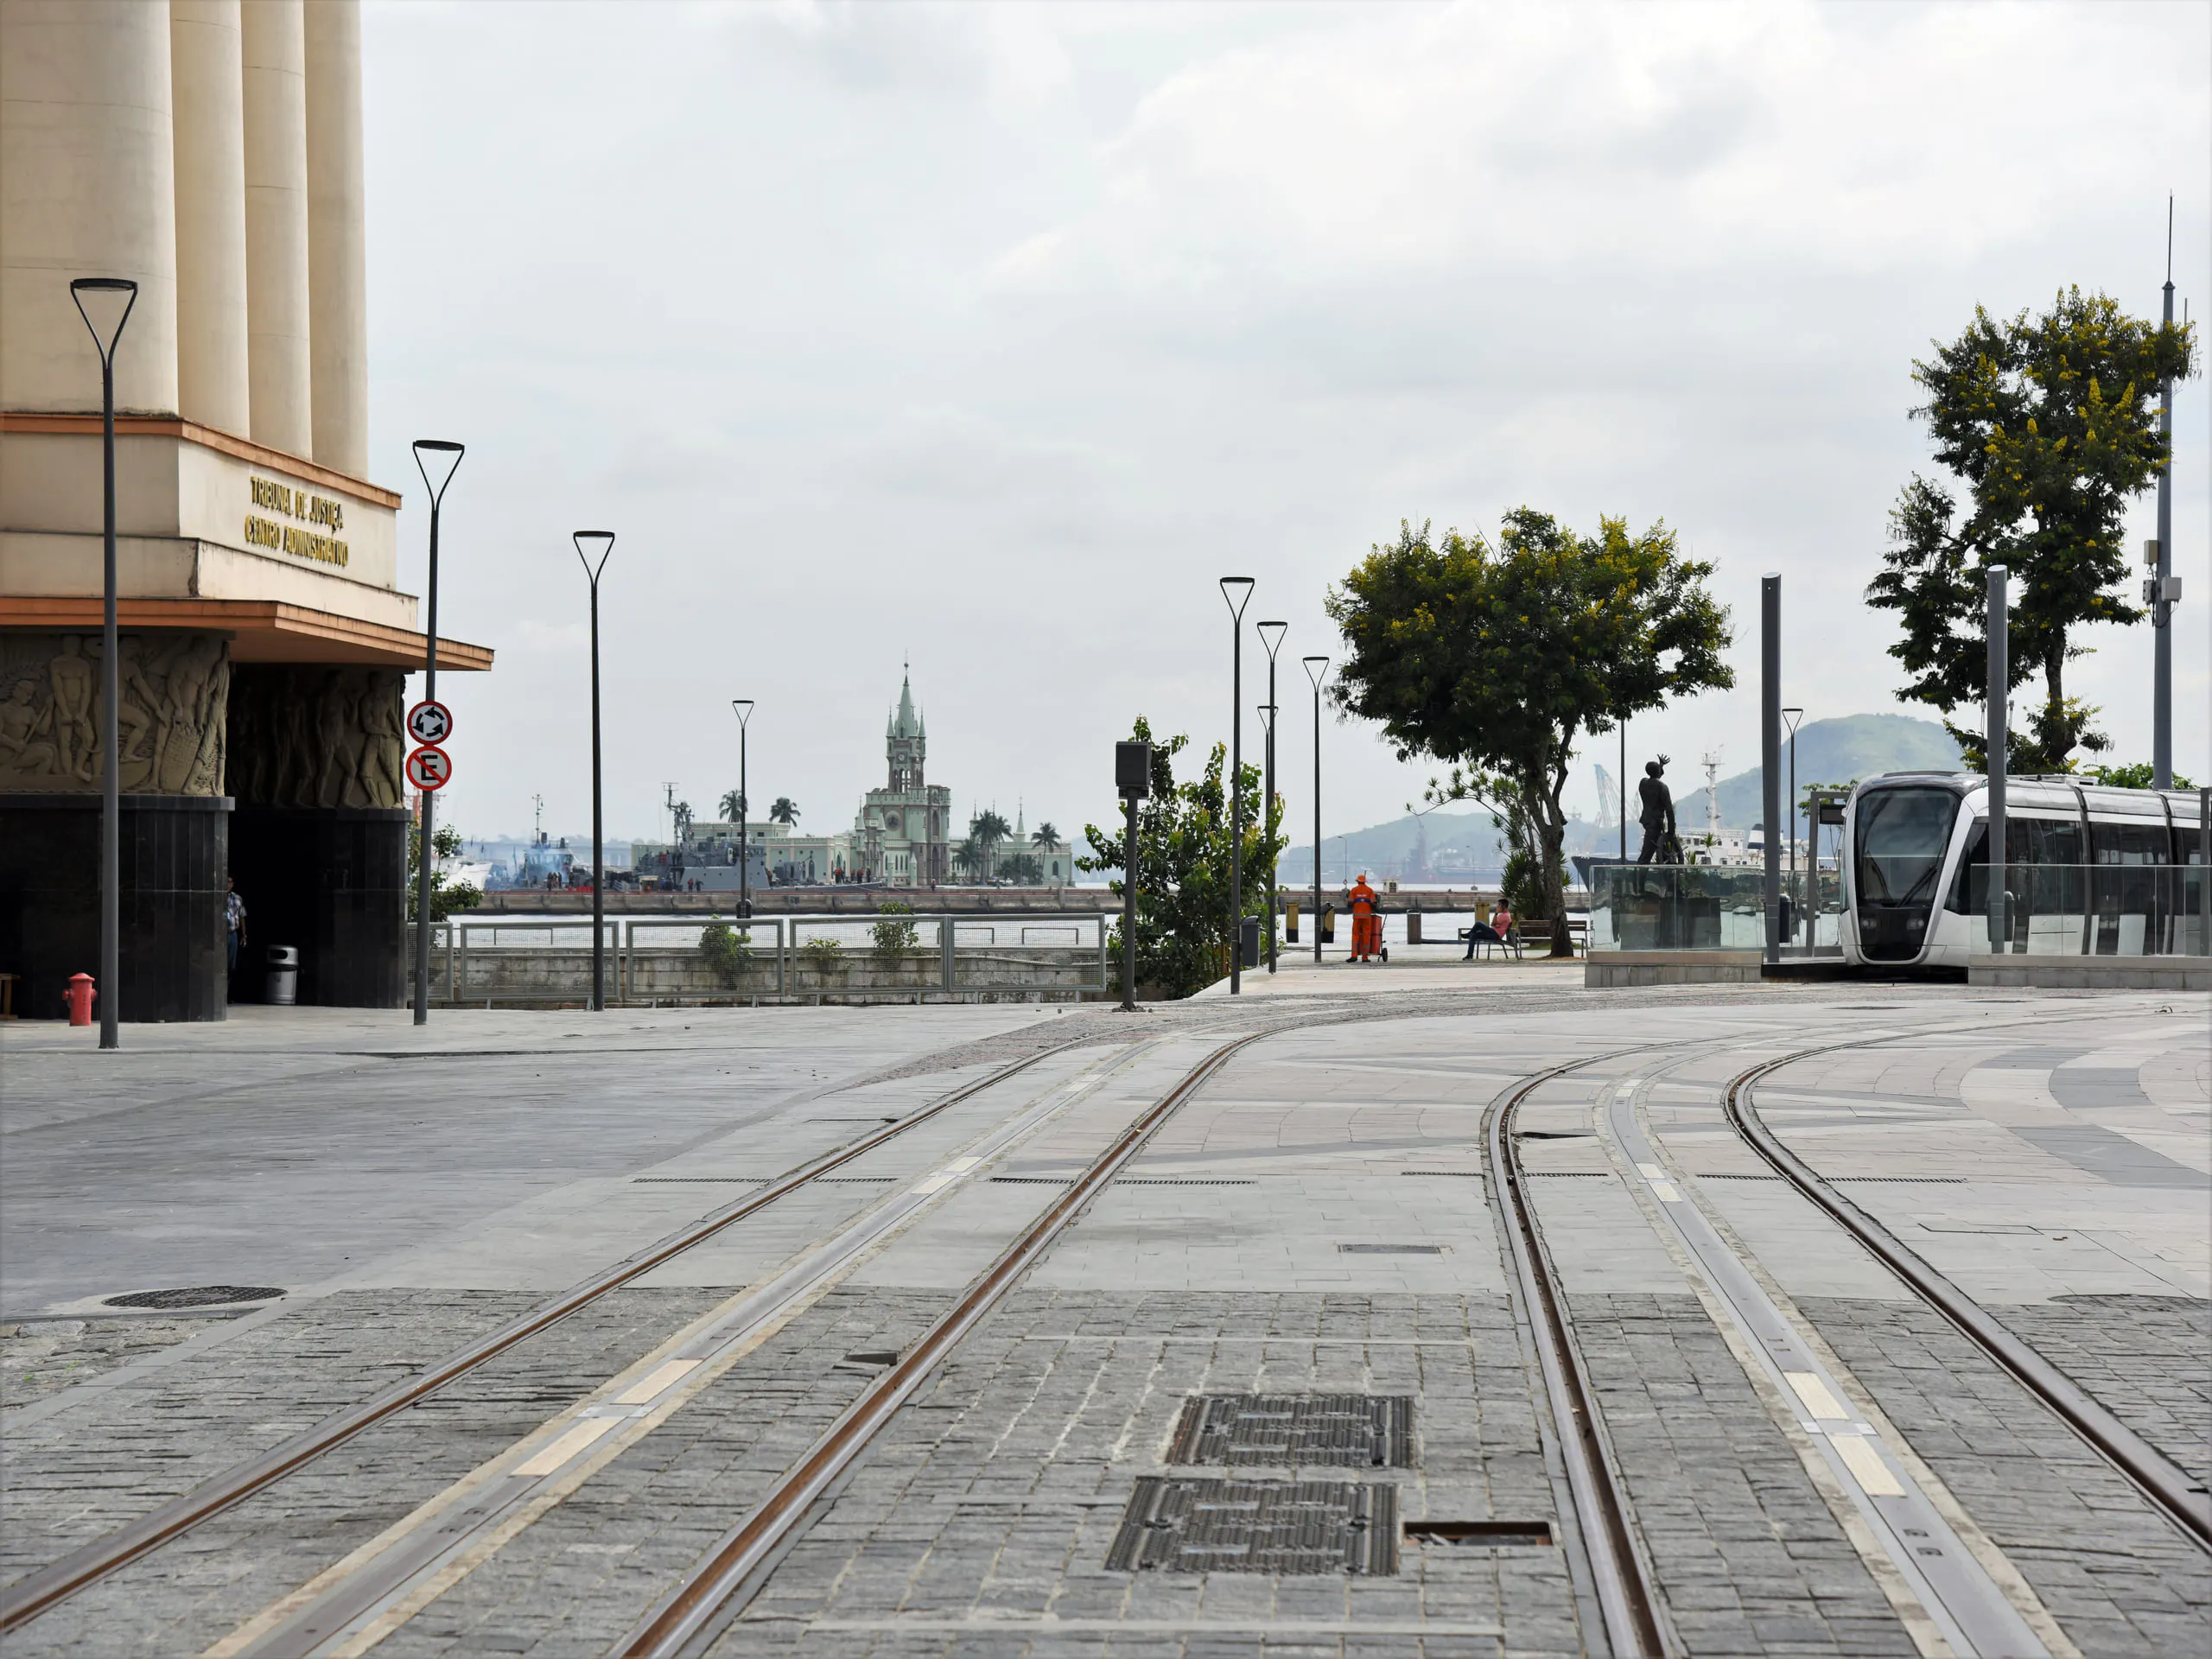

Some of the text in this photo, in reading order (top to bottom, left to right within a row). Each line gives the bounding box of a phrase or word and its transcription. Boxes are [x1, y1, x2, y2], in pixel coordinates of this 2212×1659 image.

[250, 476, 344, 533] TRIBUNAL DE JUSTIÇA
[245, 514, 348, 567] CENTRO ADMINISTRATIVO
[421, 754, 438, 781] E
